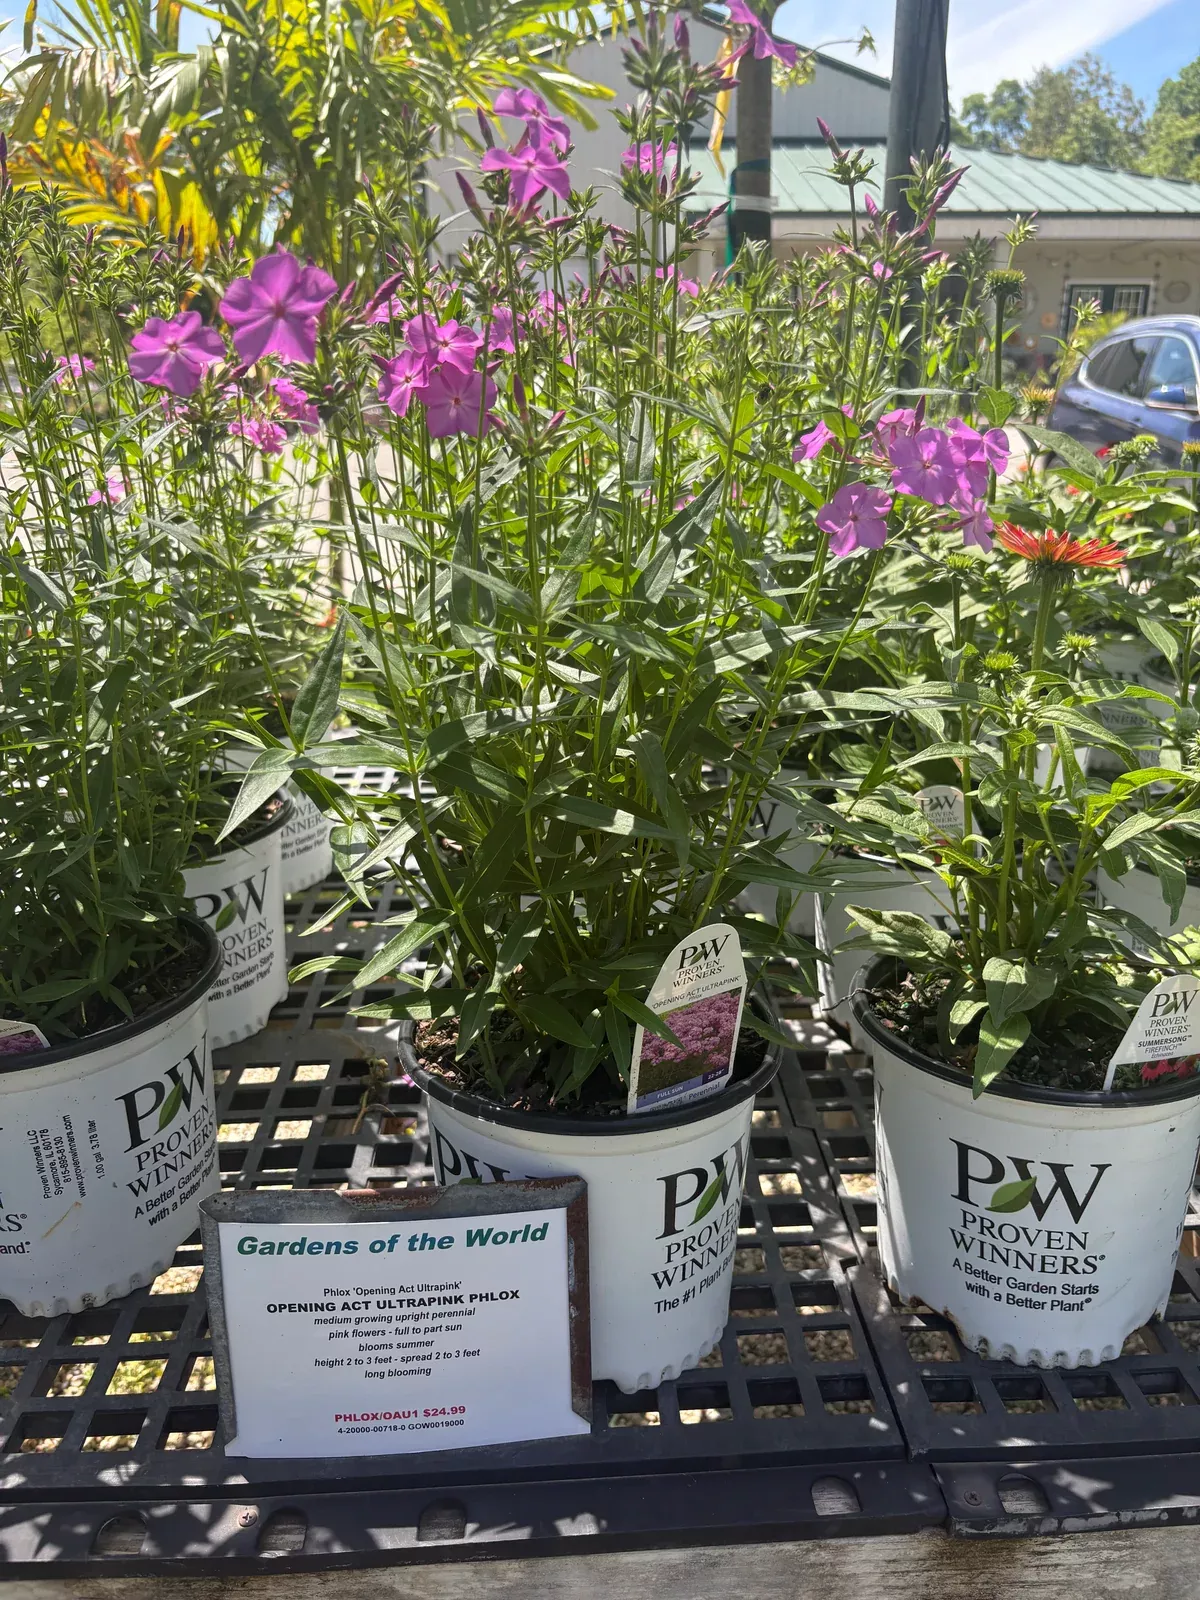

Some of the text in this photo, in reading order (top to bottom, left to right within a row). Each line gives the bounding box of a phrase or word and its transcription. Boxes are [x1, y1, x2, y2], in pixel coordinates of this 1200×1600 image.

[222, 917, 268, 951] OVEN
[676, 934, 731, 971] PW
[232, 960, 259, 982] Garden
[678, 958, 720, 979] PROVEN
[226, 987, 232, 997] a
[233, 975, 256, 994] Better
[686, 987, 700, 998] ACT
[1149, 989, 1199, 1018] PW
[1149, 1016, 1188, 1028] PROVEN
[115, 1029, 208, 1153] PW
[657, 1086, 684, 1099] FULL SUN
[688, 1082, 720, 1100] Perennial
[87, 1119, 106, 1180] 1.00 gal 3.78 liter
[135, 1097, 210, 1173] PROVEN
[27, 1129, 53, 1200] Proven Winners LLC
[39, 1128, 64, 1196] Sycamore, IL 60178
[53, 1136, 72, 1184] 815-895-8130
[62, 1114, 86, 1199] www.provenwinners.com
[134, 1206, 144, 1218] A
[146, 1185, 176, 1212] Better
[177, 1162, 204, 1191] Garden
[655, 1133, 748, 1240] PW
[949, 1137, 1112, 1224] PW
[148, 1207, 170, 1227] with
[171, 1201, 178, 1212] a
[179, 1179, 201, 1206] Better
[237, 1222, 550, 1256] Gardens of the World
[960, 1209, 1089, 1251] PROVEN
[323, 1281, 462, 1297] Phlox 'Opening Act Ultrapink'
[952, 1257, 1100, 1296] A Better Garden Starts
[266, 1289, 520, 1313] OPENING ACT ULTRAPINK PHLOX
[654, 1297, 680, 1314] The
[682, 1285, 697, 1305] #1
[699, 1269, 722, 1294] Plant
[965, 1281, 990, 1298] with
[993, 1292, 1002, 1302] a
[1006, 1293, 1047, 1310] Better
[314, 1307, 476, 1325] medium growing upright perennial
[328, 1330, 349, 1340] pink
[351, 1328, 386, 1338] flowers
[394, 1326, 410, 1336] full
[412, 1327, 422, 1335] to
[423, 1324, 443, 1335] part
[444, 1323, 462, 1331] sun
[358, 1339, 435, 1352] blooms summer
[314, 1358, 344, 1368] height
[346, 1357, 352, 1366] 2
[354, 1357, 364, 1366] to
[366, 1356, 372, 1365] 3
[374, 1356, 392, 1364] feet
[400, 1352, 433, 1364] spread
[435, 1351, 441, 1360] 2
[443, 1350, 452, 1359] to
[454, 1349, 461, 1358] 3
[463, 1348, 481, 1358] feet
[364, 1366, 432, 1379] long blooming
[334, 1405, 466, 1422] PHLOX/OAU1 $24.99
[337, 1424, 406, 1434] 4-20000-00718-0
